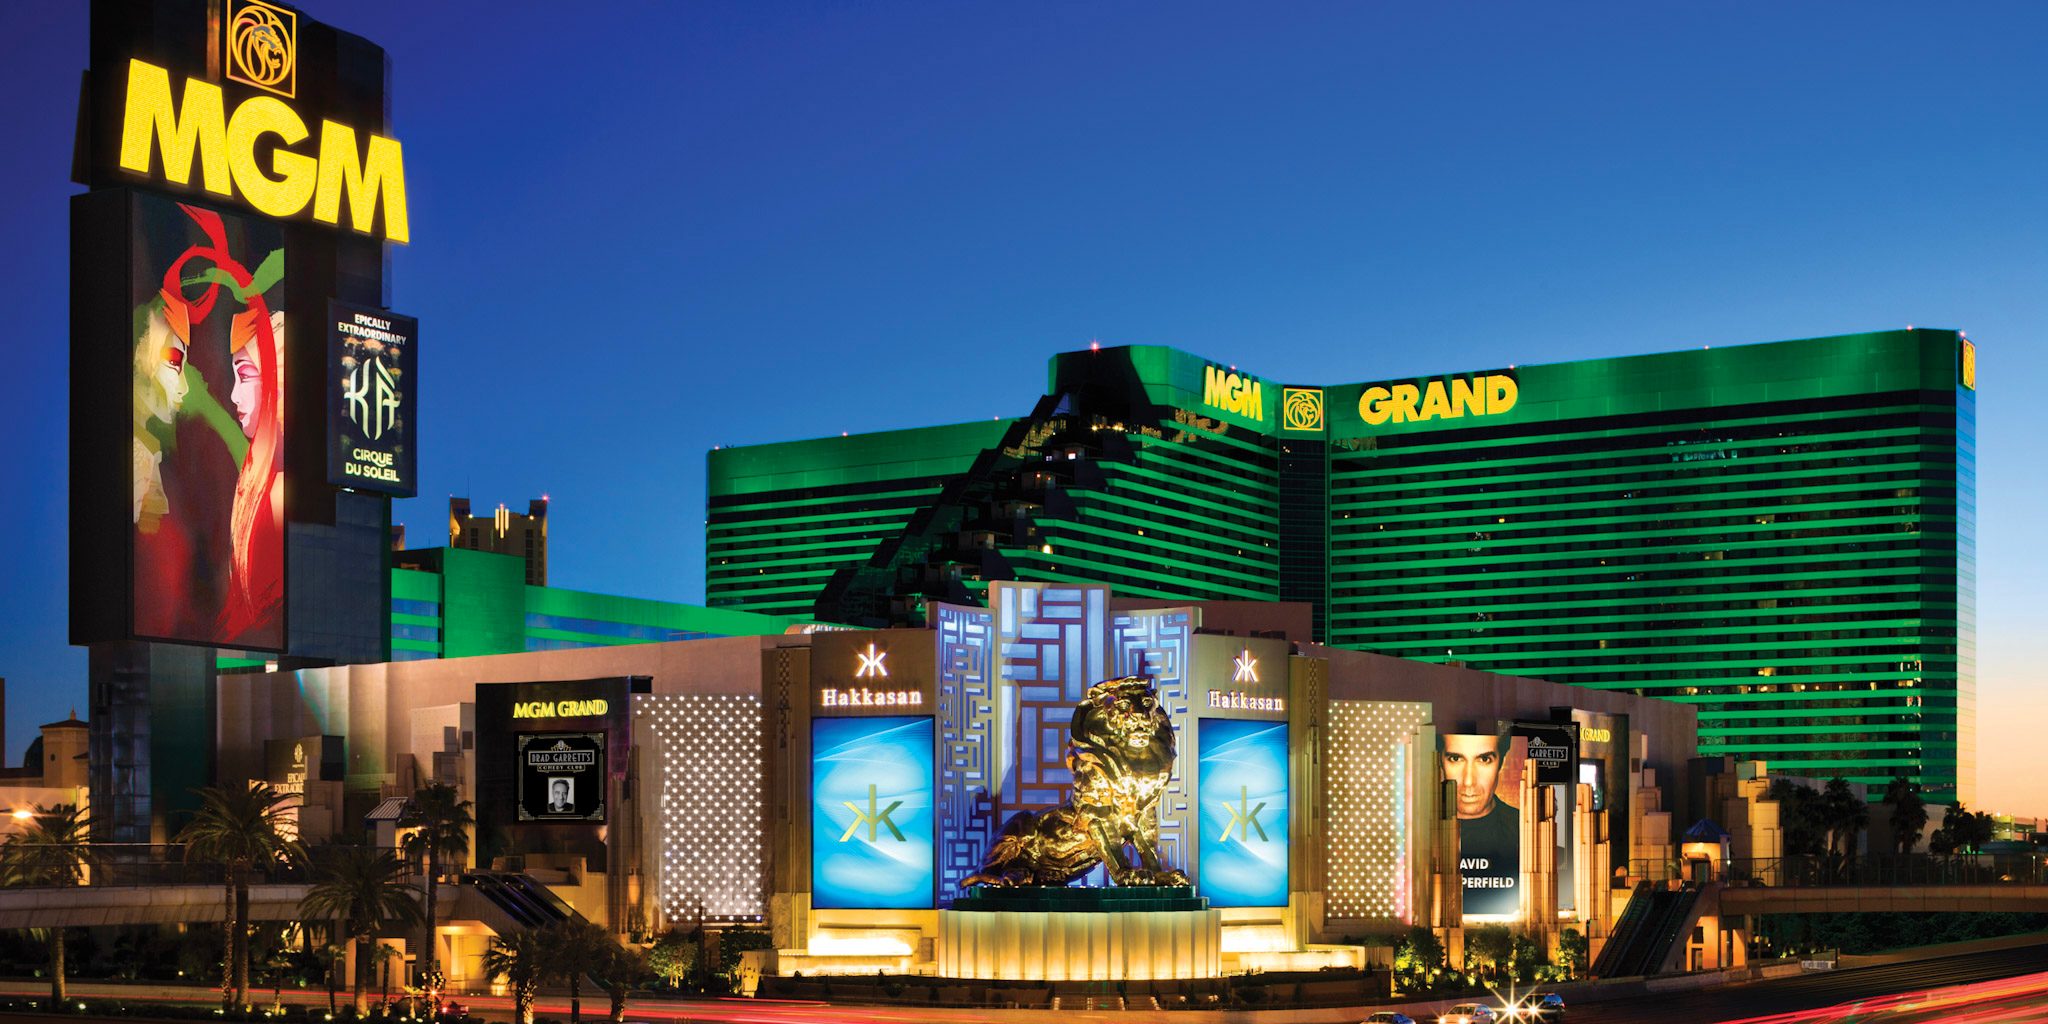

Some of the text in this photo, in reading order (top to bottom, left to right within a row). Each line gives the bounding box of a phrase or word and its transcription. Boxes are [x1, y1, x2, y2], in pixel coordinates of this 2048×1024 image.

[120, 58, 409, 243] MGM
[354, 313, 392, 331] EPICALLY
[338, 321, 407, 345] EXTRAORDINARY
[1204, 365, 1263, 422] MGM
[1358, 375, 1518, 425] GRAND
[353, 448, 393, 467] CIRQUE
[345, 462, 400, 482] DU SOLEIL
[821, 687, 923, 706] Hakkasan
[1207, 690, 1285, 711] Hakkasan
[513, 699, 608, 718] MGM GRAND
[531, 752, 591, 763] BRAD GARRETT'S
